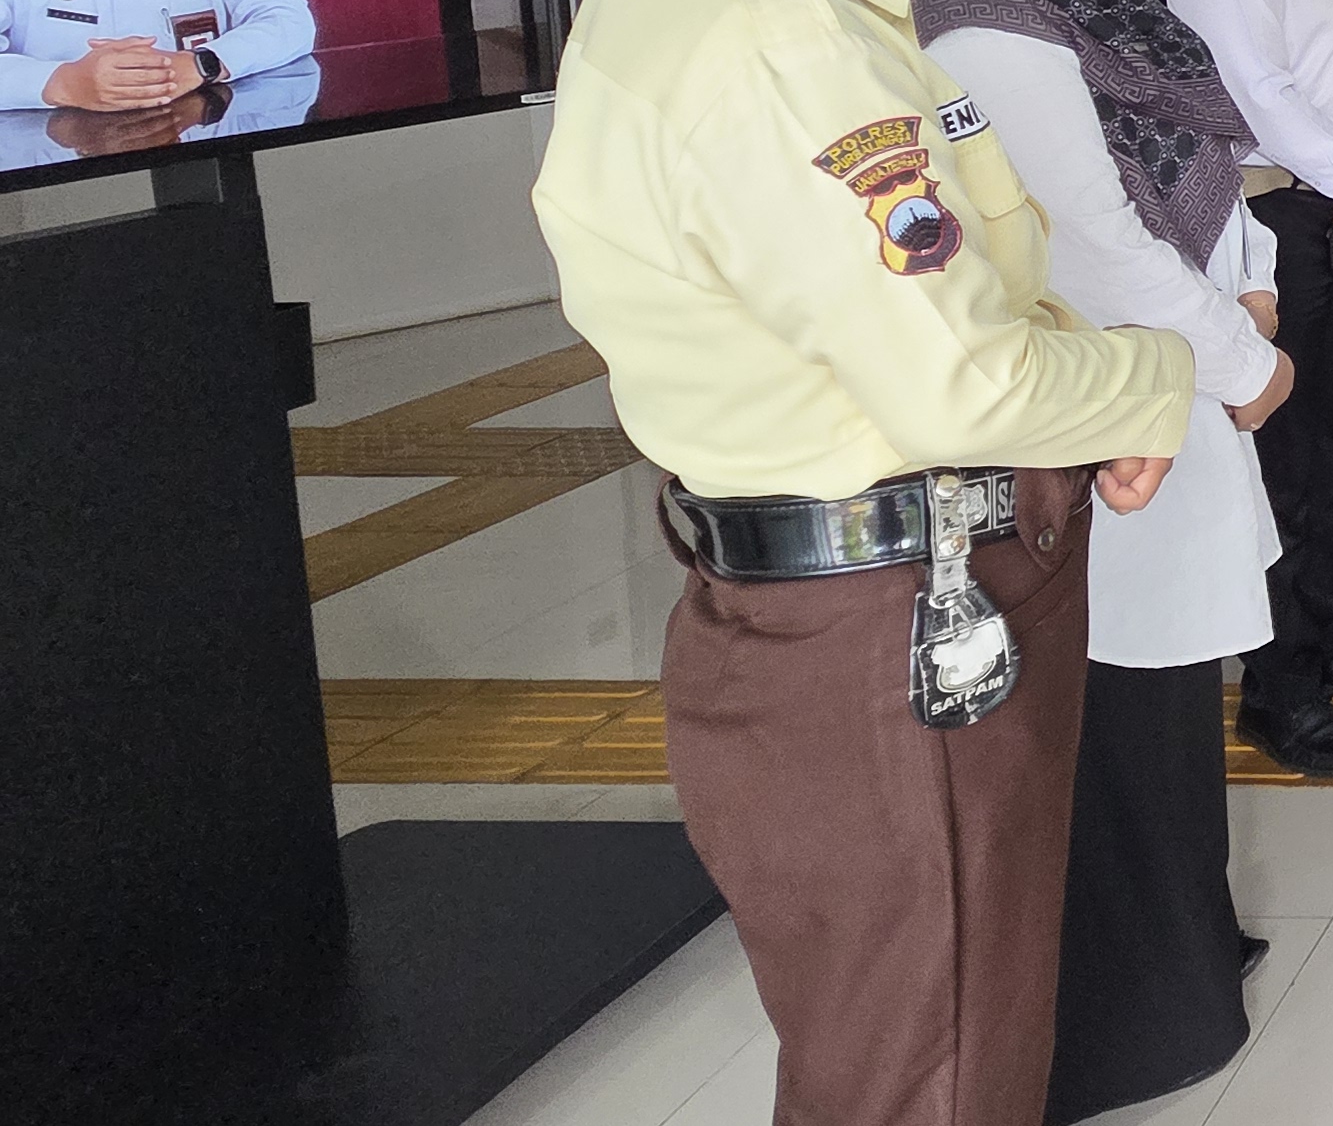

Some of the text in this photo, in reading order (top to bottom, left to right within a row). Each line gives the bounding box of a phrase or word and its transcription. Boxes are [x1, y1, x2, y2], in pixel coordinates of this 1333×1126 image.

[828, 120, 906, 160] POLRES
[831, 132, 912, 175] PURBALINGGA
[855, 166, 888, 192] JAWA
[930, 675, 1004, 716] SATPAM
